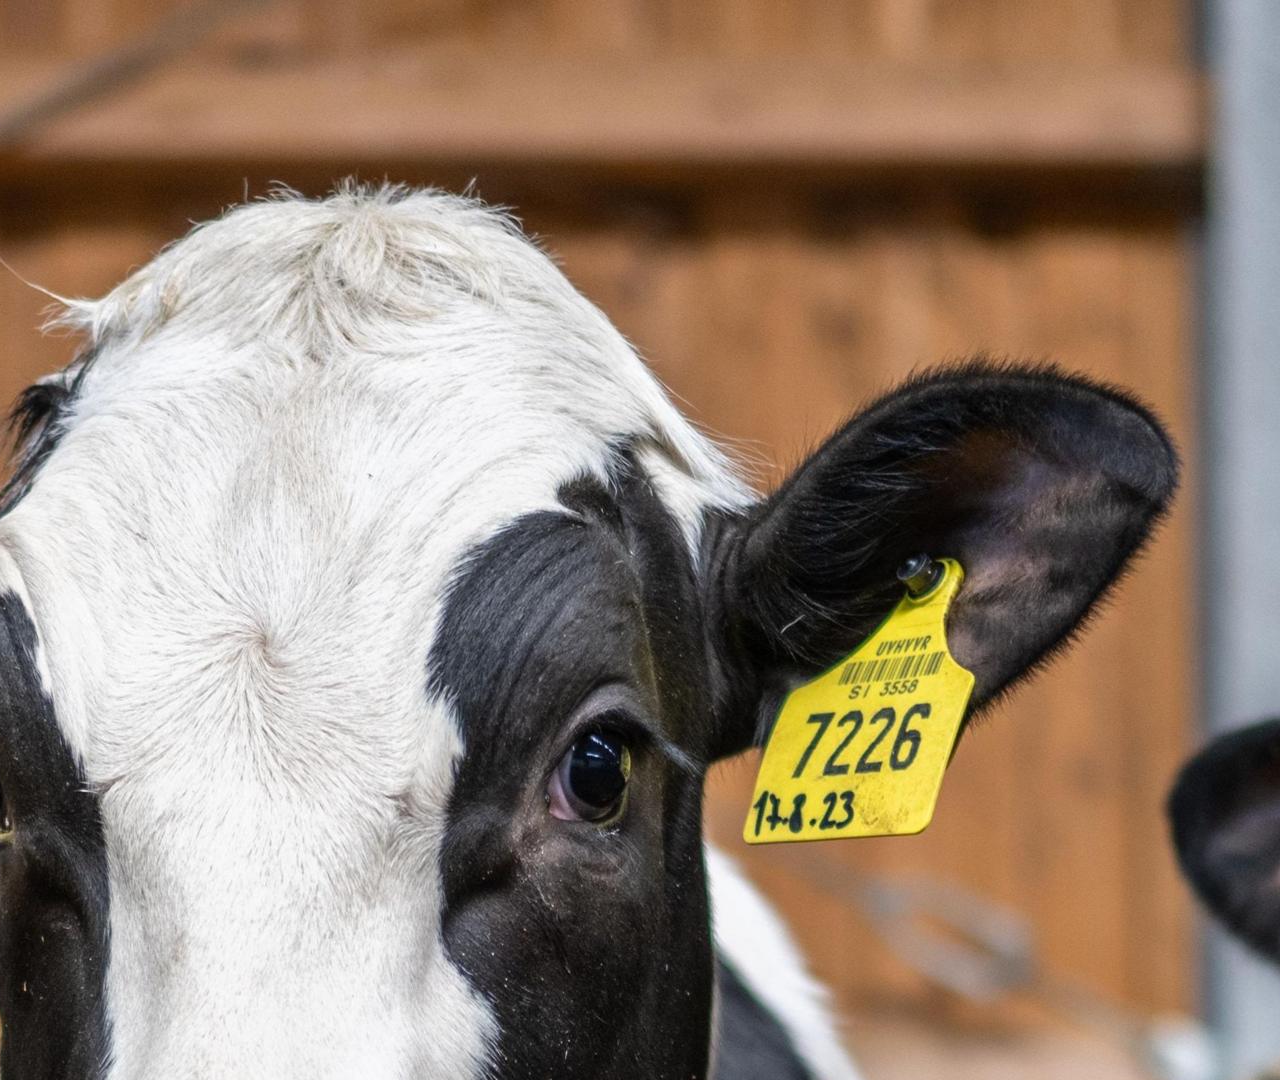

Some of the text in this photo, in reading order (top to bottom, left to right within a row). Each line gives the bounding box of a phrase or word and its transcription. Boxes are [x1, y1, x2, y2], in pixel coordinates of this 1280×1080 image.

[880, 679, 919, 697] 3558
[791, 702, 932, 778] 7226
[753, 790, 855, 837] 17.8.23
